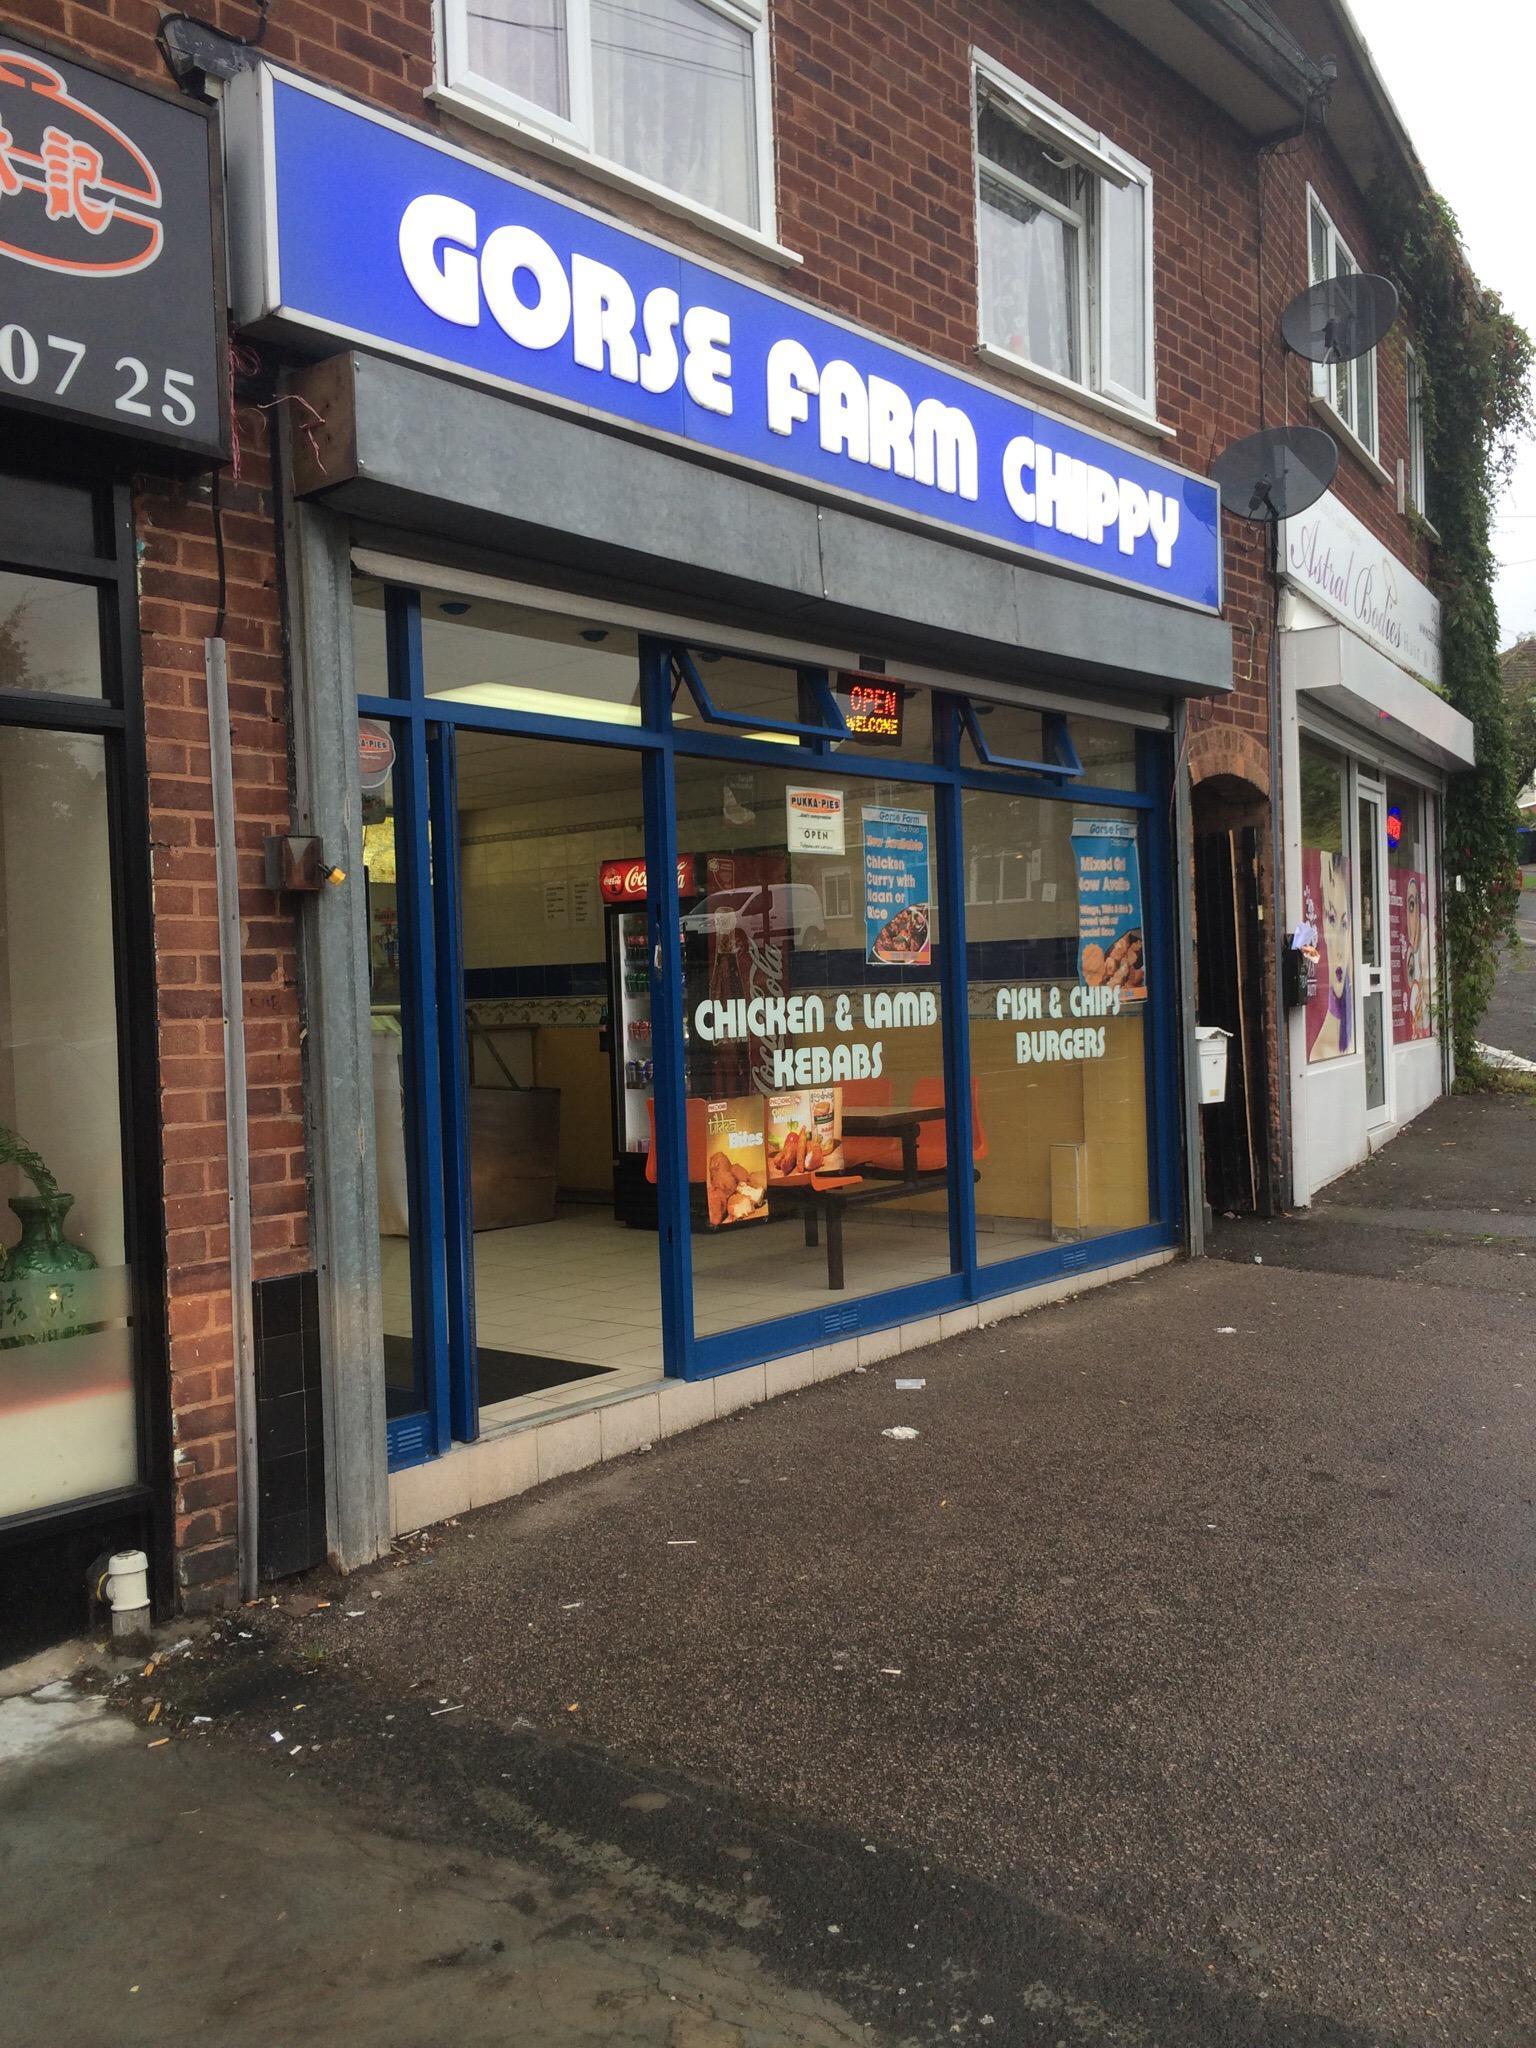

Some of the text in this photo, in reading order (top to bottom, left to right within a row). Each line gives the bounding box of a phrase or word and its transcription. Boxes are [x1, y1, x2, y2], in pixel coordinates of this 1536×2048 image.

[115, 356, 197, 427] 25
[398, 193, 1180, 568] GORSE FARM CHIPPY
[1290, 519, 1355, 607] Astral
[850, 685, 897, 716] OPEN
[846, 714, 899, 735] WELCOME
[902, 813, 920, 823] Farm
[804, 829, 829, 840] OPEN
[866, 855, 905, 870] Chicken
[1081, 856, 1113, 872] Mixed
[867, 872, 915, 888] Curry with
[695, 991, 938, 1041] CHICKEN & LAMB
[996, 984, 1121, 1021] FISH & CHIPS
[1016, 1026, 1105, 1064] BURGERS
[773, 1041, 883, 1088] KEBABS
[728, 1131, 763, 1148] Bites
